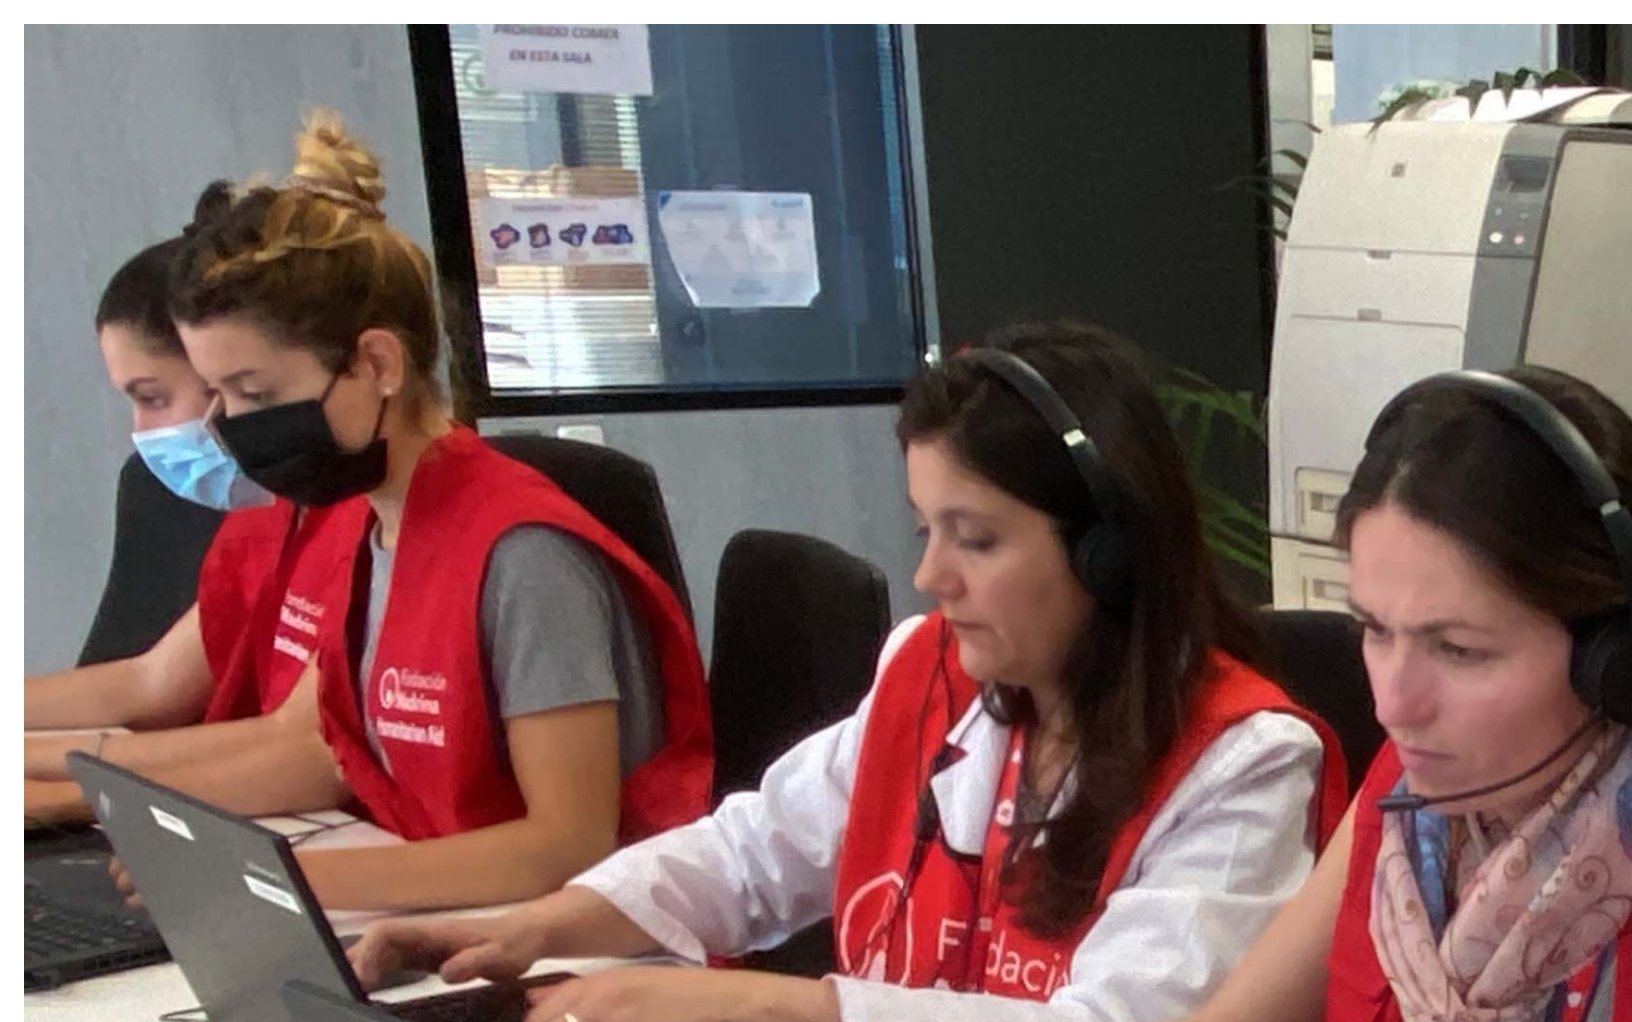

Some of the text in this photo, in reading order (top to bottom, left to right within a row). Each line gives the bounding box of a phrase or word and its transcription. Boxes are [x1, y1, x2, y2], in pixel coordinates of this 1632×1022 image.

[493, 24, 619, 39] PROHIBIDO COMER
[509, 50, 593, 64] EN ESTA SALA
